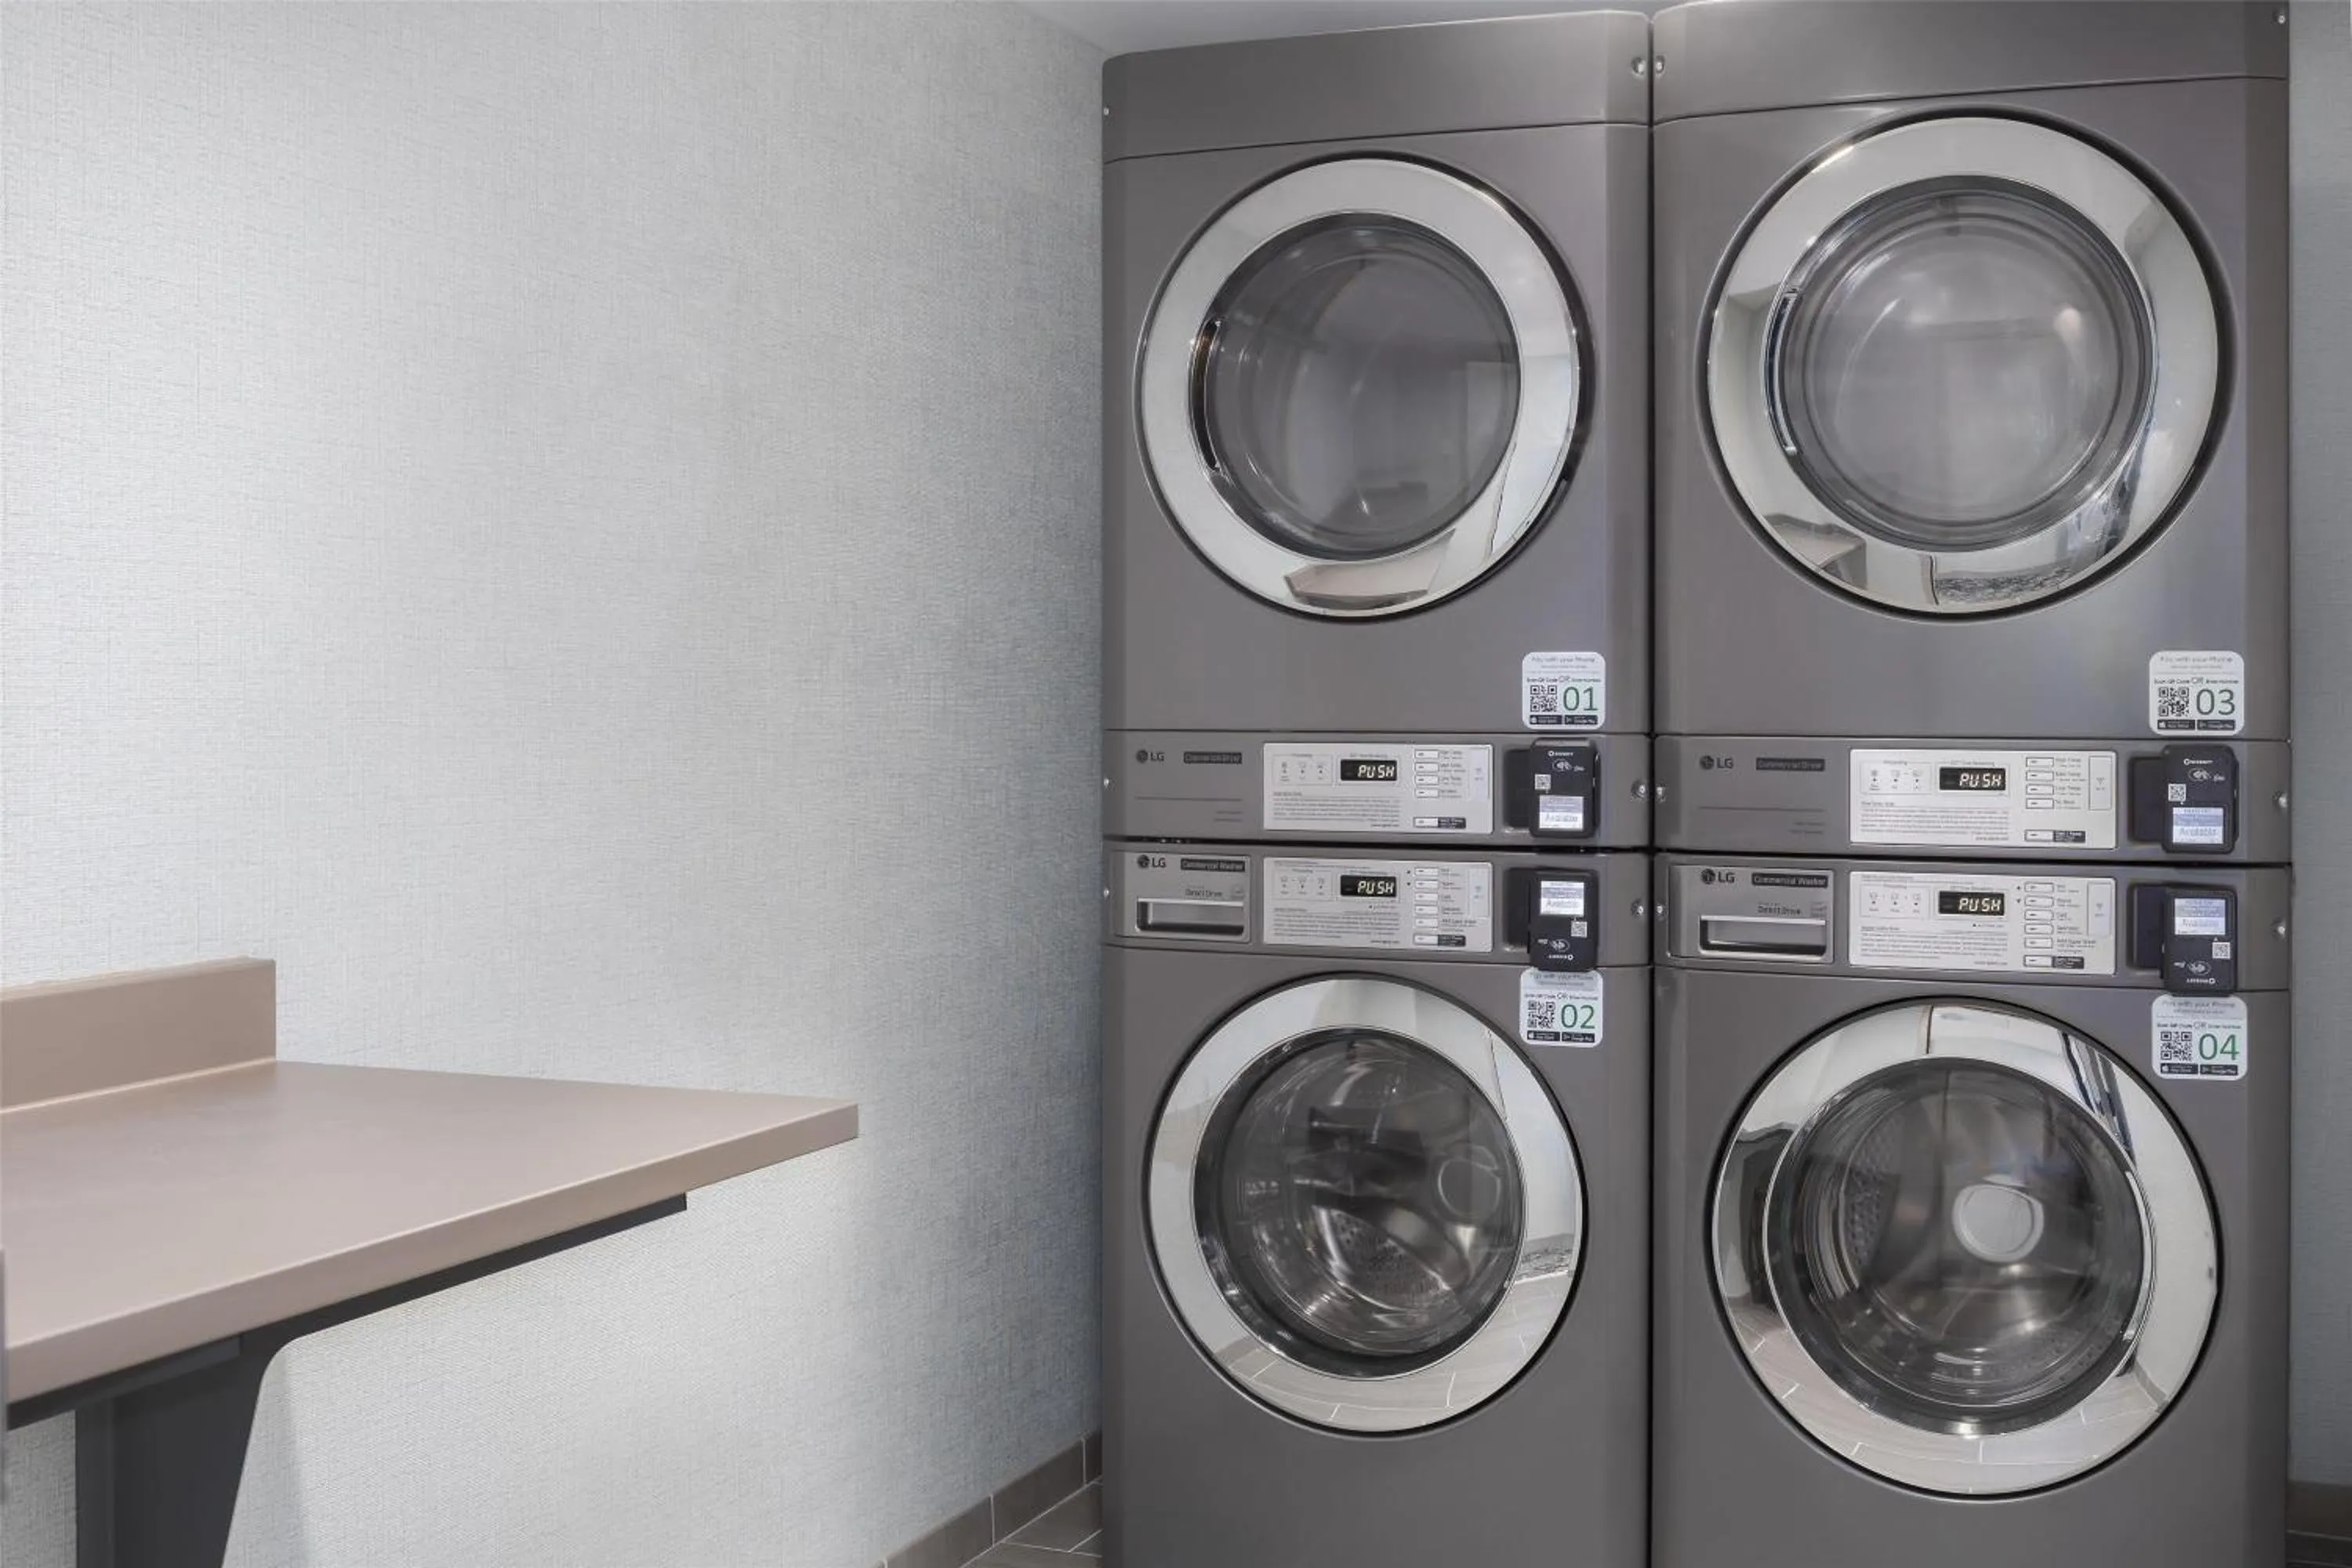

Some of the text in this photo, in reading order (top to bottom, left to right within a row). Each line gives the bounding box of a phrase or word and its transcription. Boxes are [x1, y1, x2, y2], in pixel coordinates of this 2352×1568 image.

[1563, 686, 1599, 711] 01
[2196, 689, 2235, 715] 03
[1150, 752, 1165, 762] LG
[1717, 758, 1734, 770] LG
[1357, 764, 1396, 779] PUSH
[1959, 772, 2002, 788] PUSH
[1152, 857, 1167, 868] LG
[1718, 872, 1736, 884] LG
[1357, 880, 1395, 895] PUSH
[1958, 897, 2001, 913] PUSH
[1561, 1004, 1595, 1029] 02
[2198, 1033, 2240, 1061] 04
